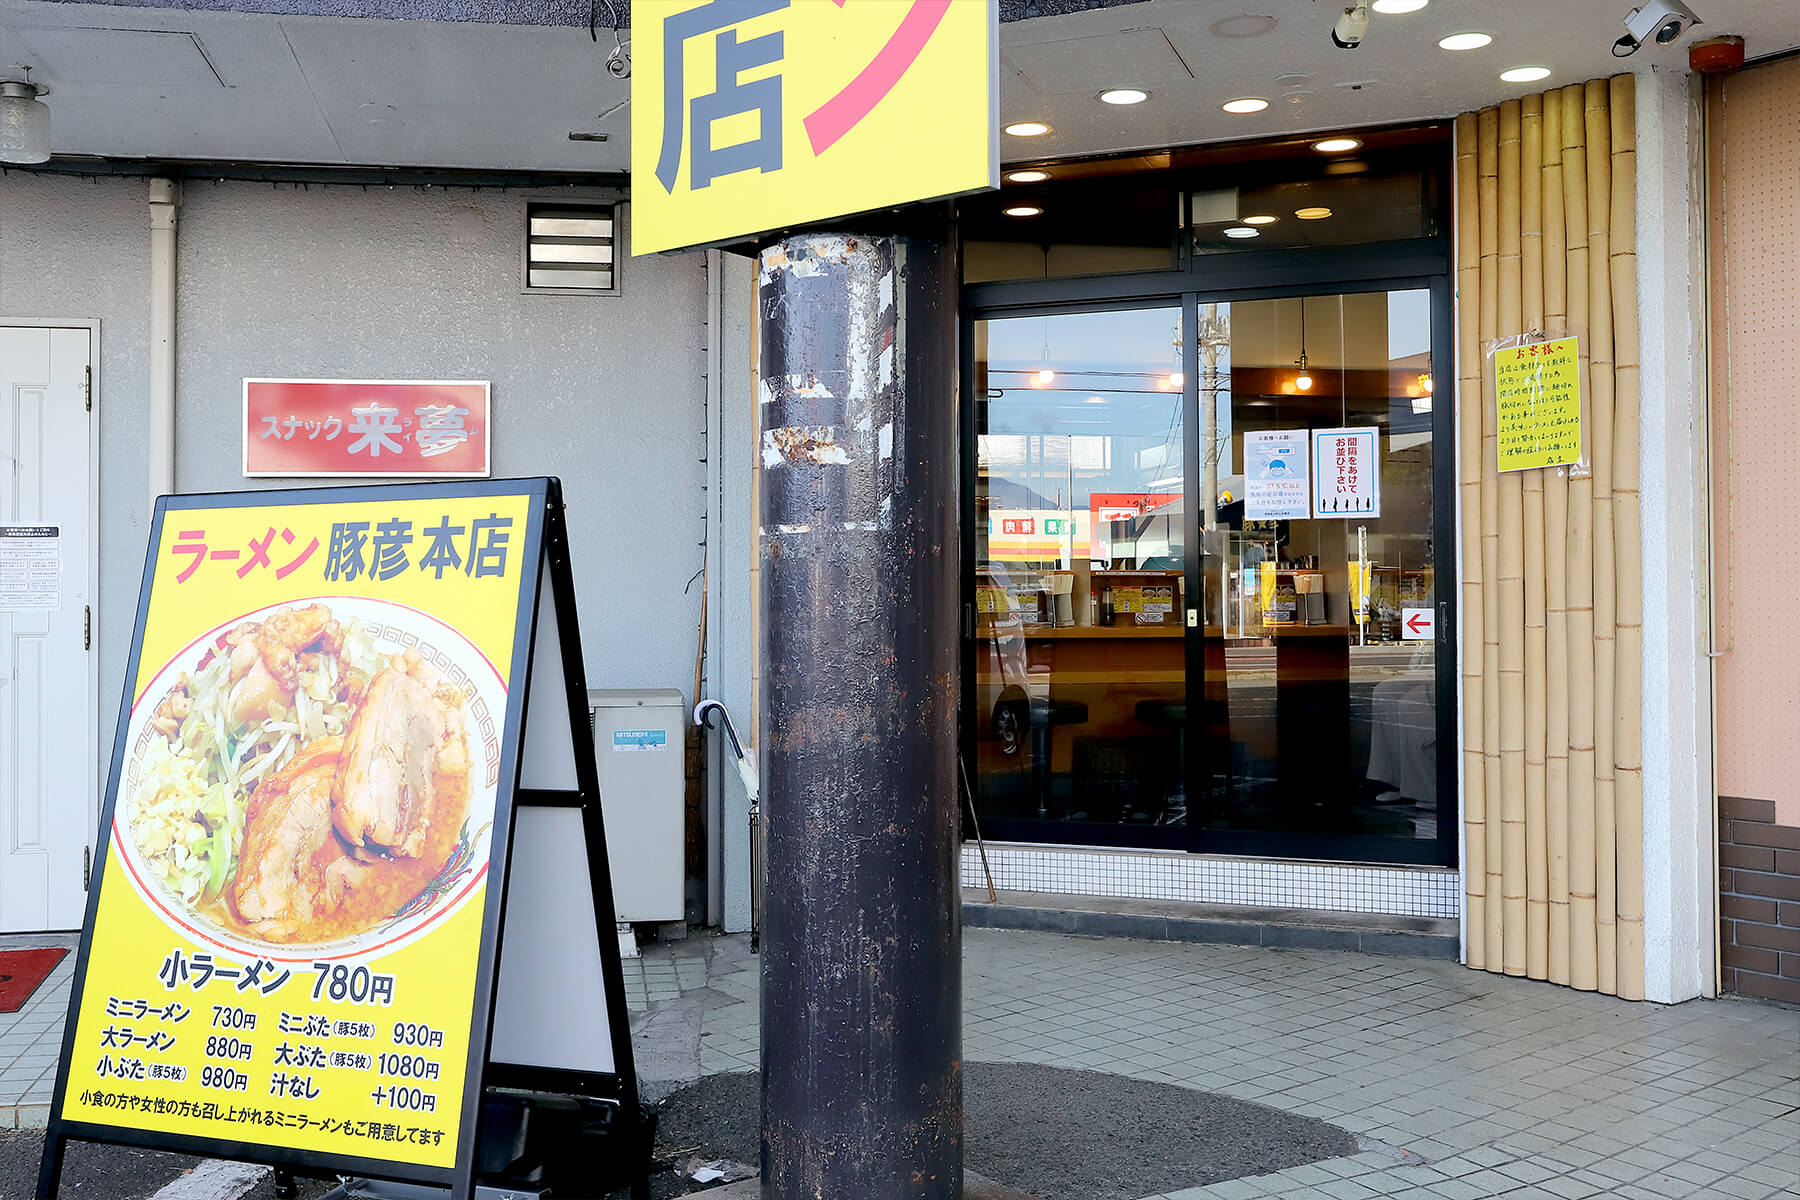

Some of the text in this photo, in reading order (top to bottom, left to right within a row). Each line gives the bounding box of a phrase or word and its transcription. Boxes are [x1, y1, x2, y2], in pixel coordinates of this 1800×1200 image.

[1516, 343, 1564, 359] お客様へ
[260, 415, 342, 440] スナック
[1335, 438, 1347, 494] お並び下さい
[1347, 437, 1358, 494] 間隔をあけて
[172, 512, 514, 585] ラーメン 豚彦本店
[159, 950, 394, 1004] 小ラーメン 780円
[105, 997, 256, 1030] ミニラーメン 730円
[100, 1025, 252, 1060] 大ラーメン 880円
[393, 1022, 443, 1048] 930円
[201, 1066, 248, 1091] 980円
[378, 1053, 440, 1079] 1080円
[270, 1072, 436, 1112] 汁なし +100円
[79, 1089, 446, 1147] 小食の方や女性の方も召し上がれるミニラーメンもご用意してます
